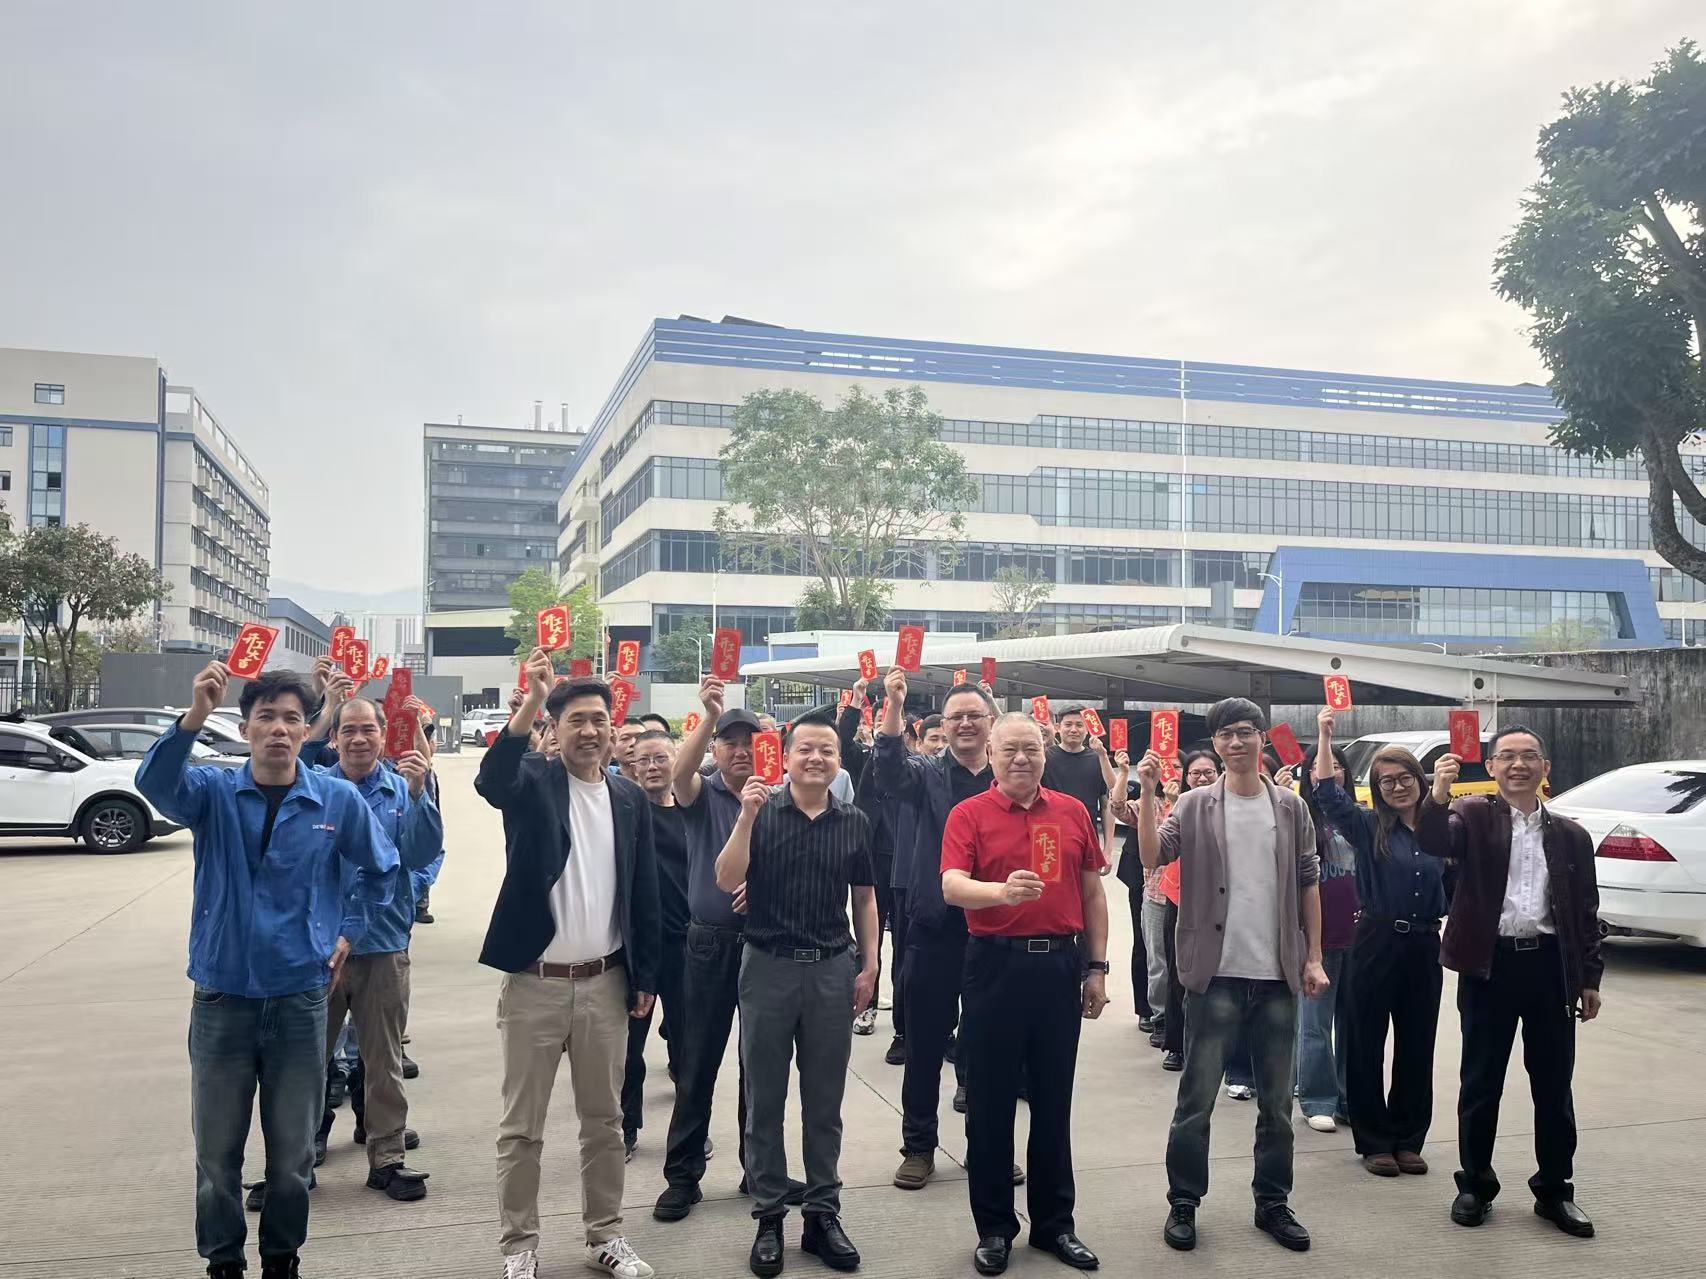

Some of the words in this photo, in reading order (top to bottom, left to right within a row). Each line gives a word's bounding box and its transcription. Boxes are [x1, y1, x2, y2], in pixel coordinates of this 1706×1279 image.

[541, 613, 564, 645] 开工大吉
[239, 632, 266, 669] 开工大吉
[346, 645, 365, 675] 开工大吉
[718, 637, 735, 672] 开工大吉
[902, 633, 918, 665] 开工大吉
[1328, 680, 1347, 706] 开工大吉
[1154, 717, 1173, 751] 开工大吉
[757, 741, 778, 777] 开工大吉
[1035, 832, 1056, 873] 开工大吉
